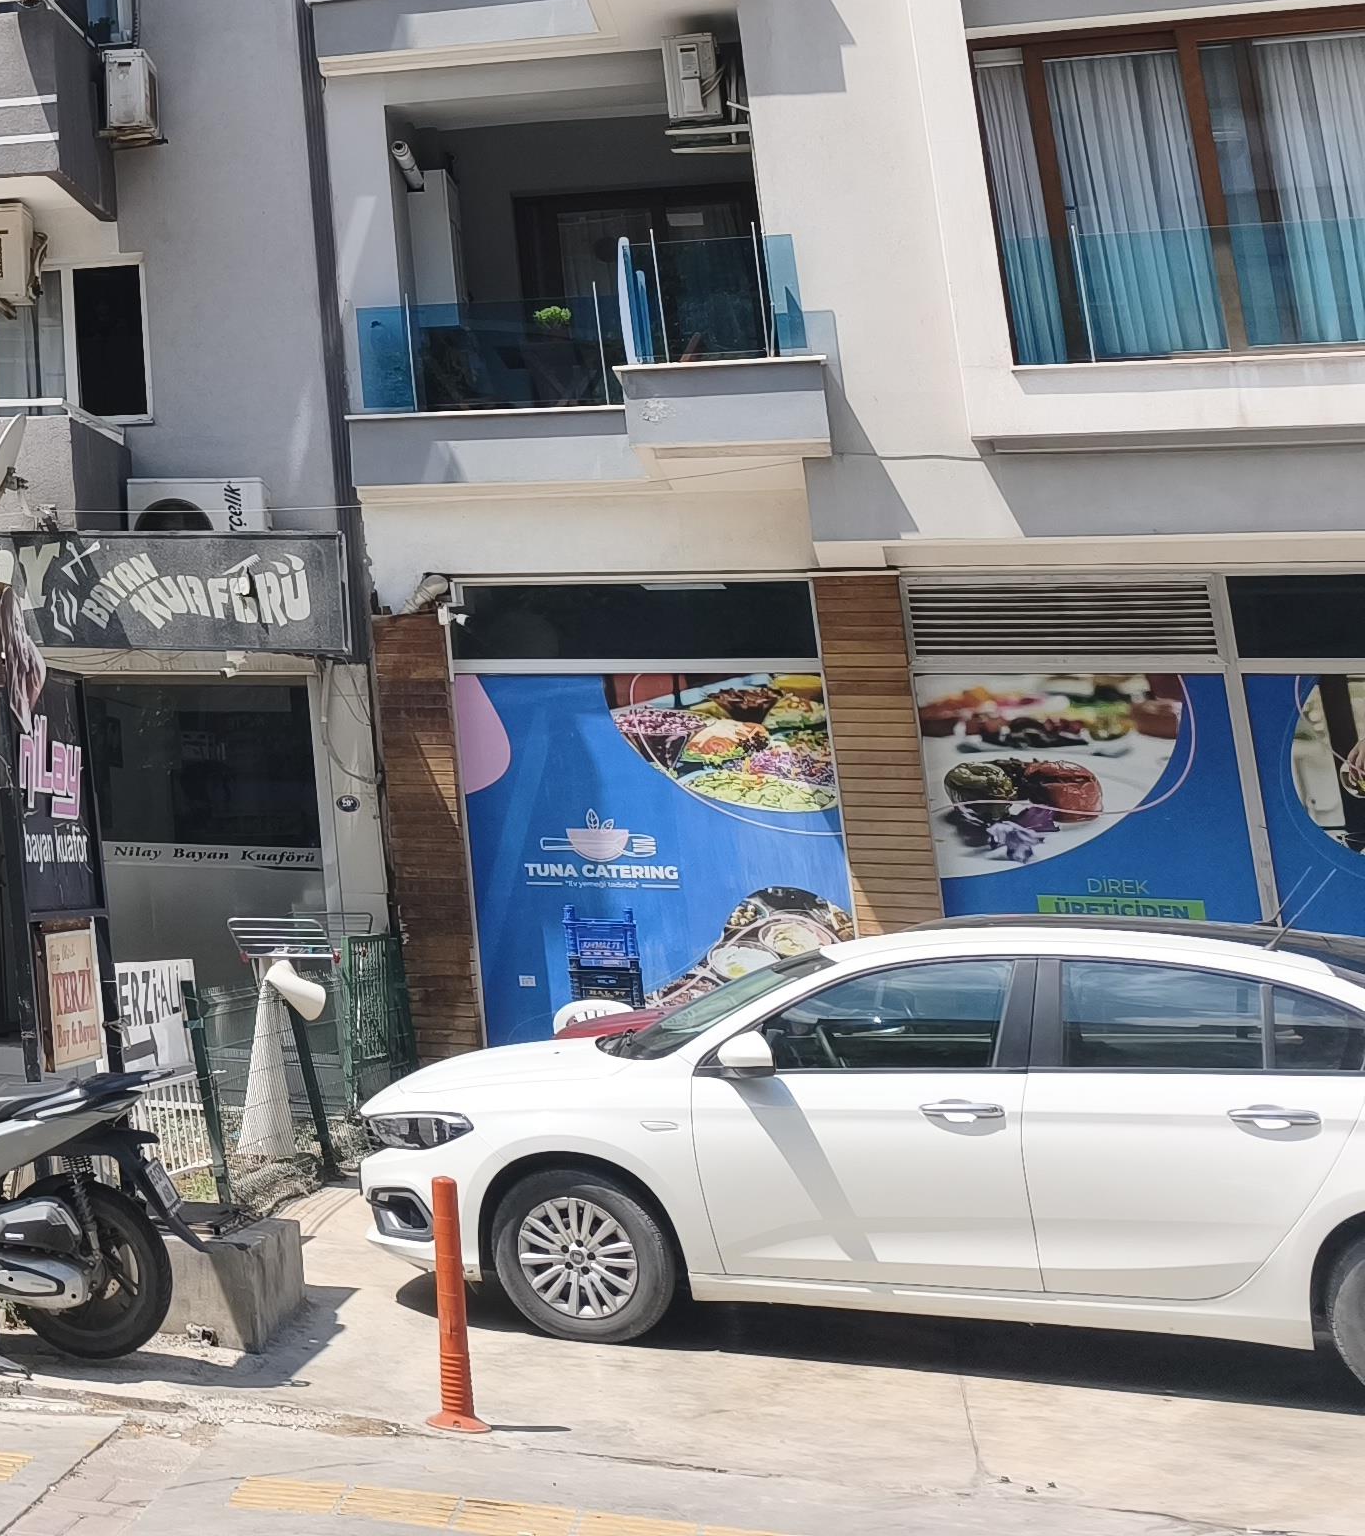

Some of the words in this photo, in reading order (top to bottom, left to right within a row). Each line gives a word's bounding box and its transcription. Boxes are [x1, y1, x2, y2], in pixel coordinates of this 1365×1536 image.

[227, 480, 247, 531] rçelik
[22, 823, 54, 873] bayan
[114, 846, 162, 861] Nilay
[173, 847, 229, 861] Bayan
[240, 849, 315, 864] Kuaförü
[524, 863, 579, 879] TUNA
[581, 864, 679, 880] CATERING
[1086, 875, 1150, 895] DİREK
[52, 957, 93, 1016] TERZİ
